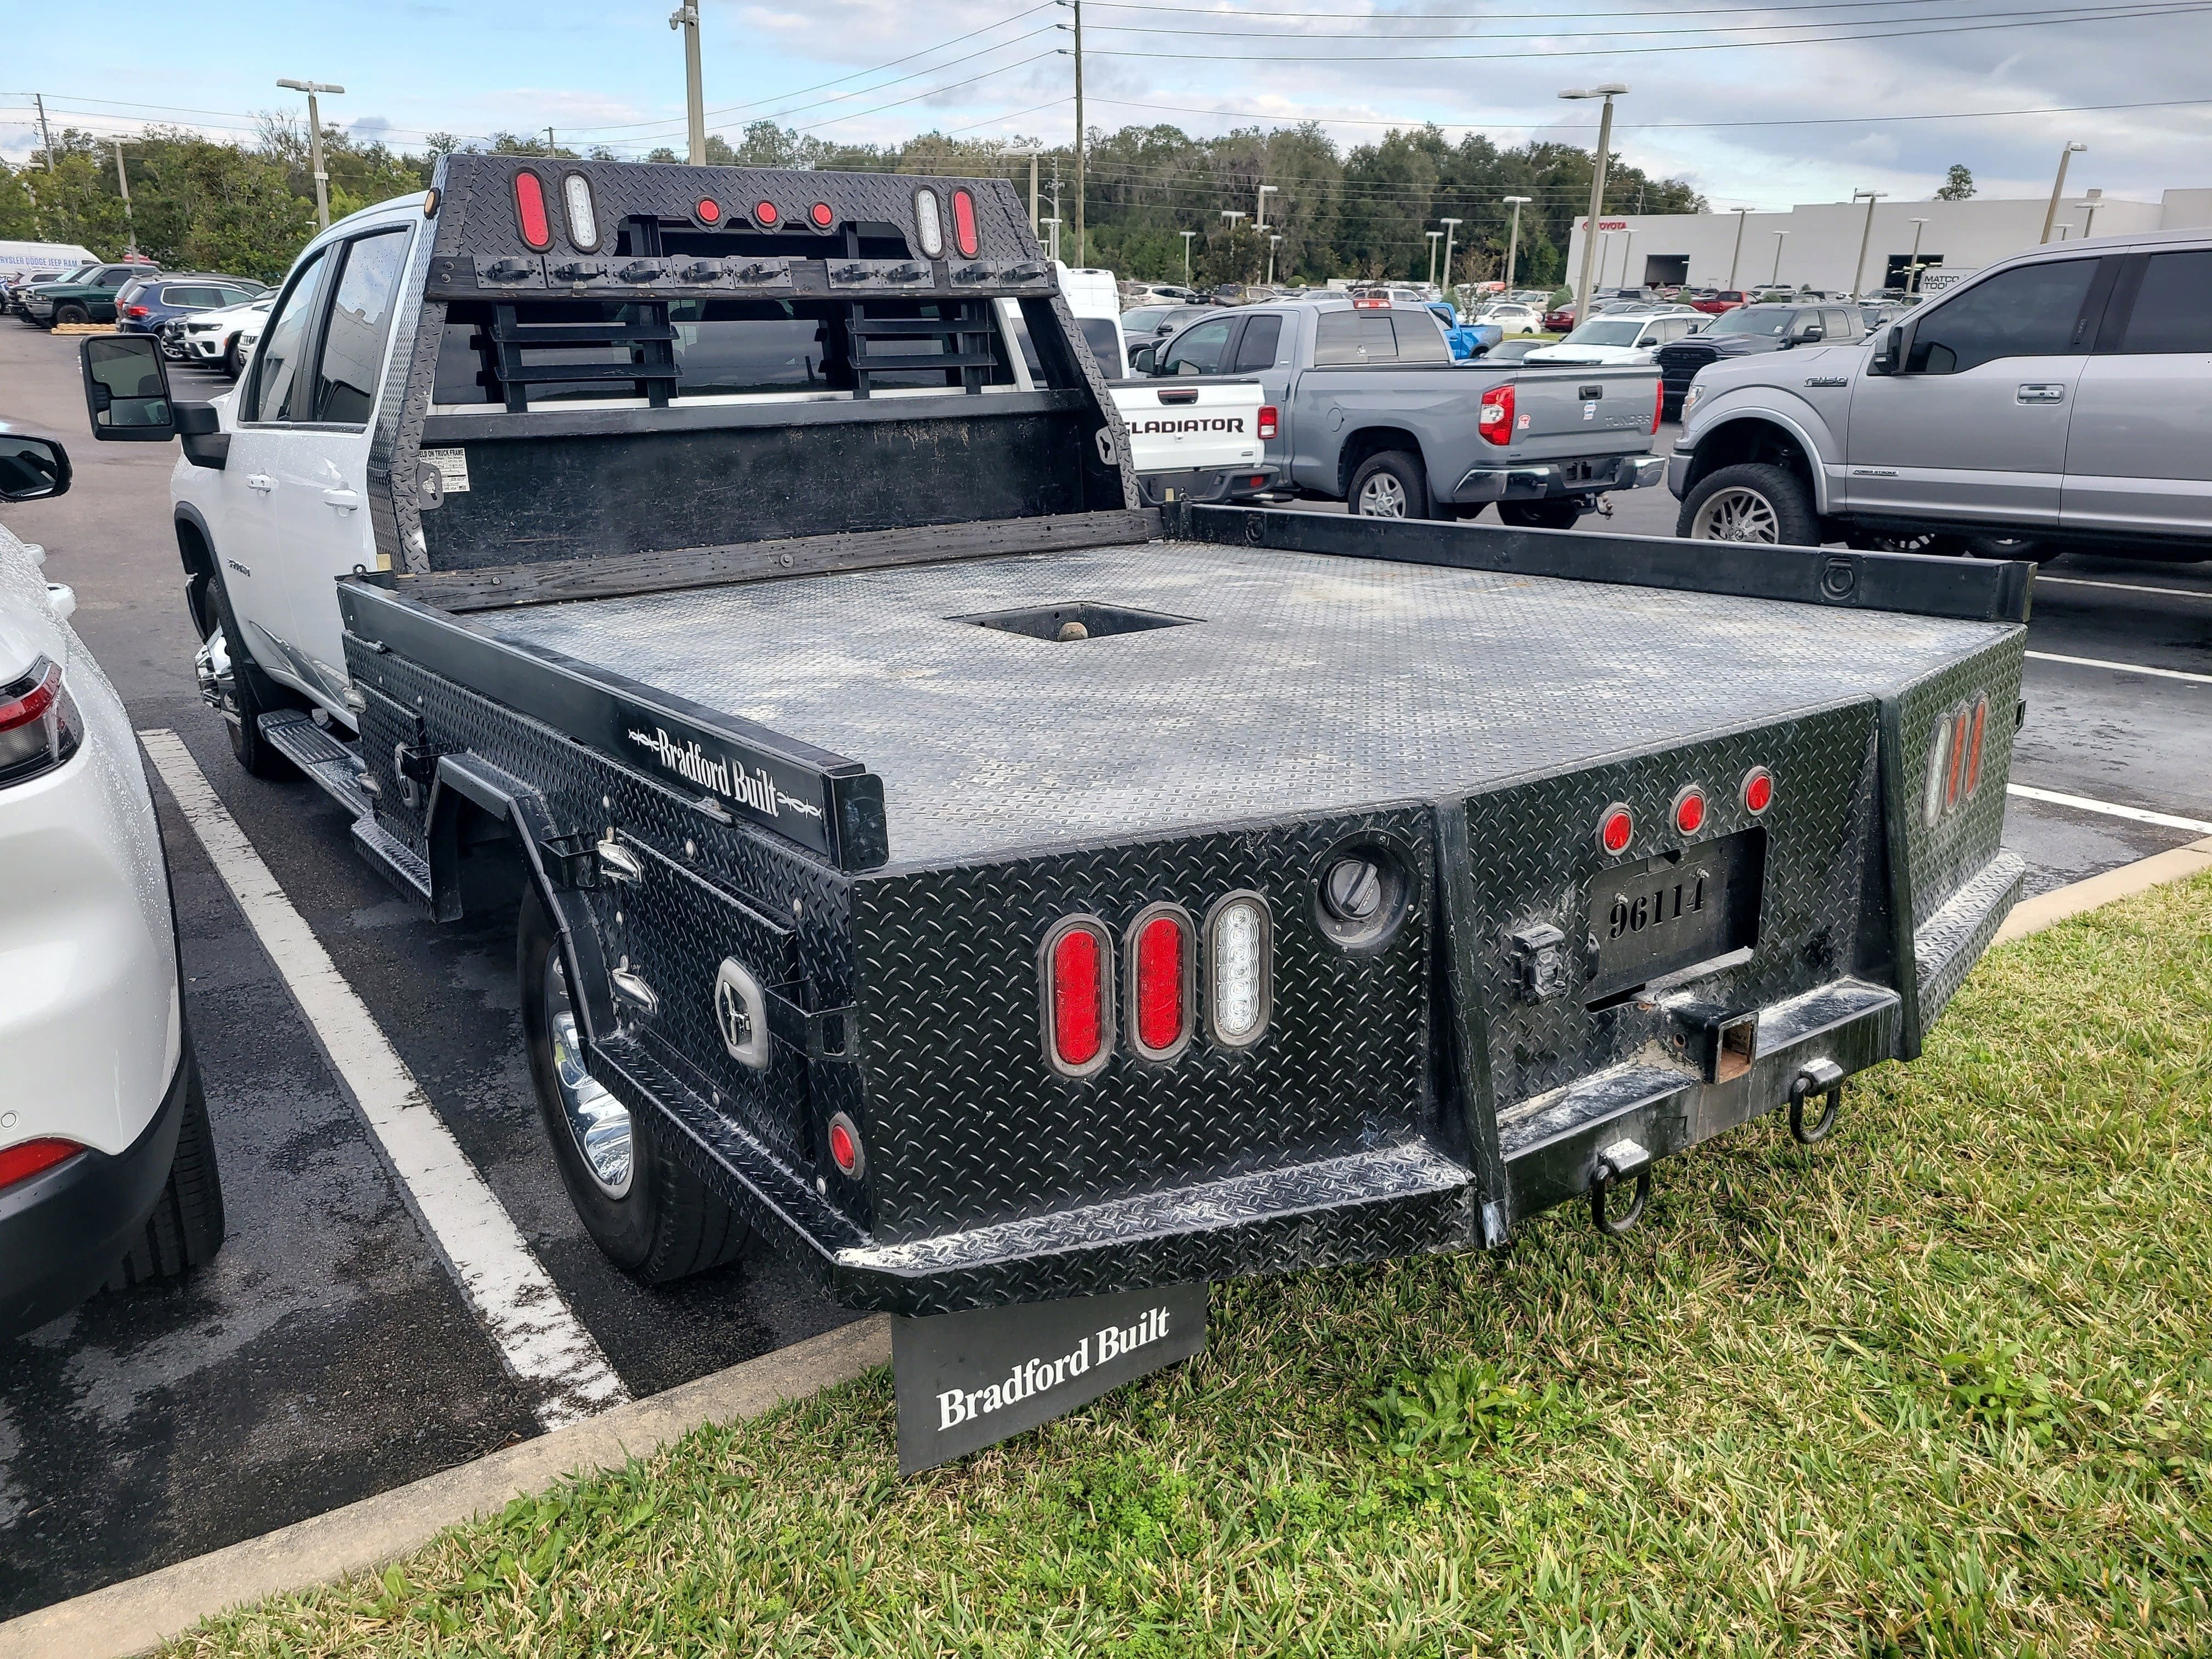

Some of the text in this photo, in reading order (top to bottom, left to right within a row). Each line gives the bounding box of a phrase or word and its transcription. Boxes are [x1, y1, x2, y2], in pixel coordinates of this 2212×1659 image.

[0, 256, 24, 264] RYSLER
[27, 257, 47, 266] DODGE
[48, 258, 62, 267] JEEP
[656, 727, 779, 817] Bradford Built
[1609, 877, 1704, 940] 96114
[936, 1306, 1170, 1432] Bradford Built
